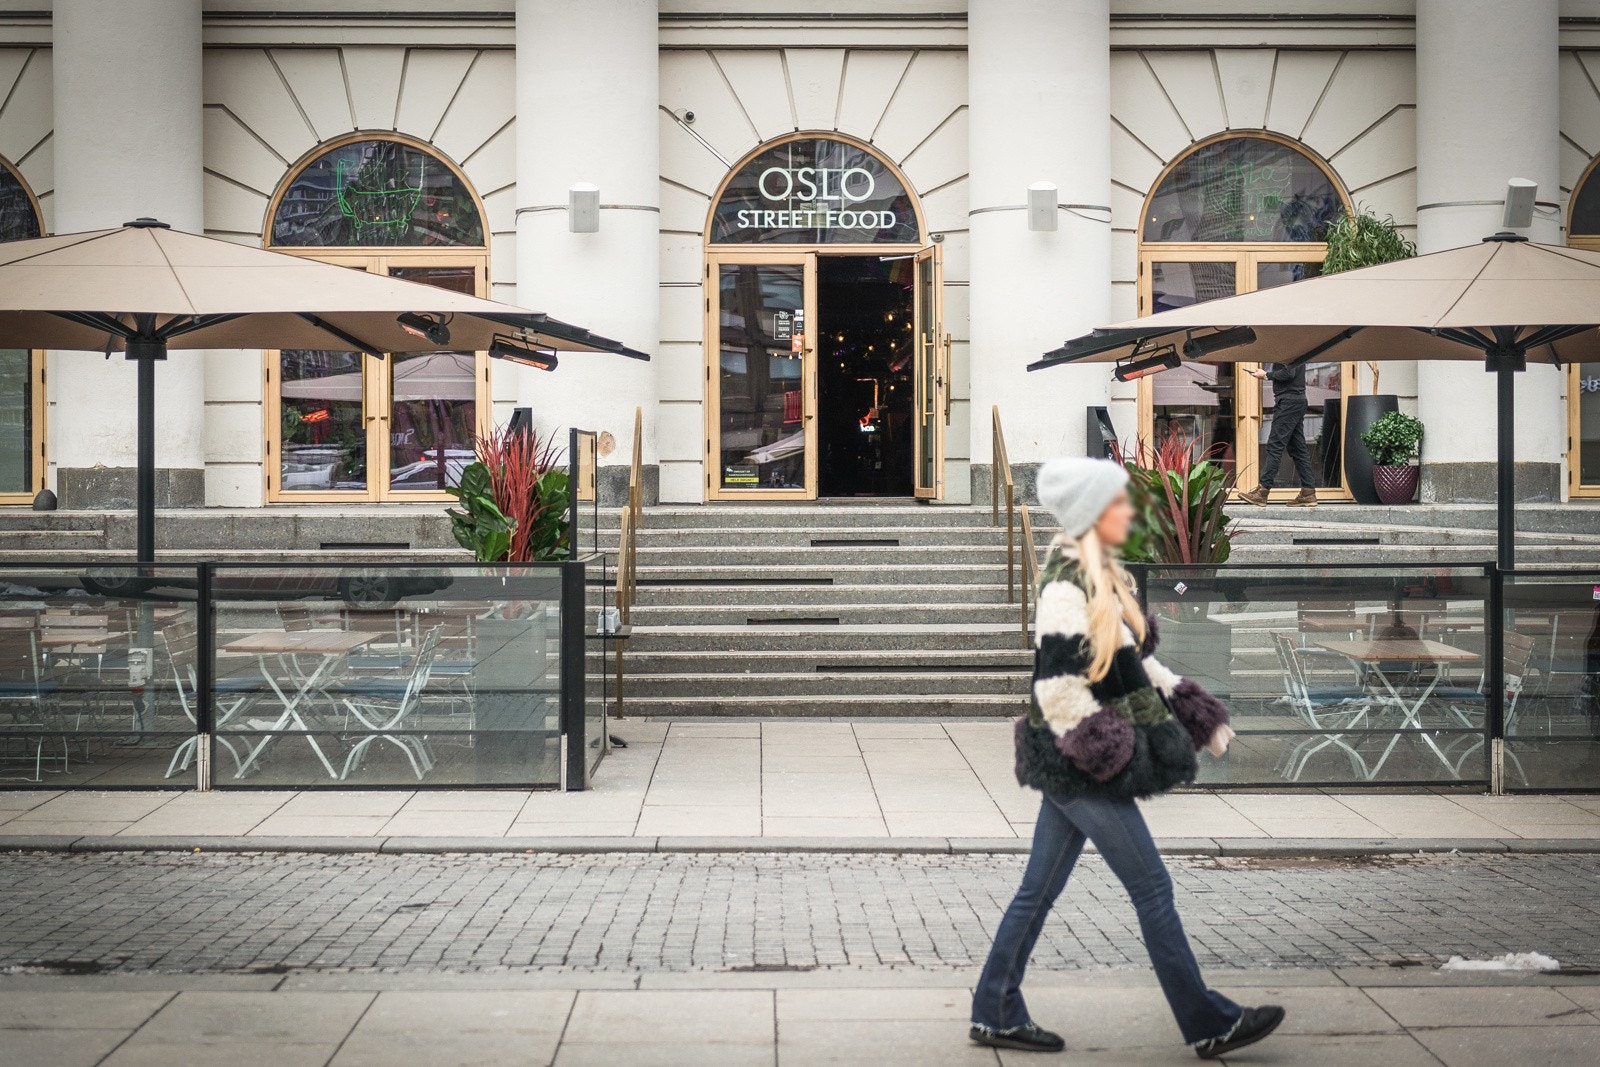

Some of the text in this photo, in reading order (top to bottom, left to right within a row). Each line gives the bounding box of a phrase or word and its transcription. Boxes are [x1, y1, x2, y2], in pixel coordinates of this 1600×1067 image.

[759, 167, 875, 201] OSLO
[737, 210, 896, 229] STREET FOOD
